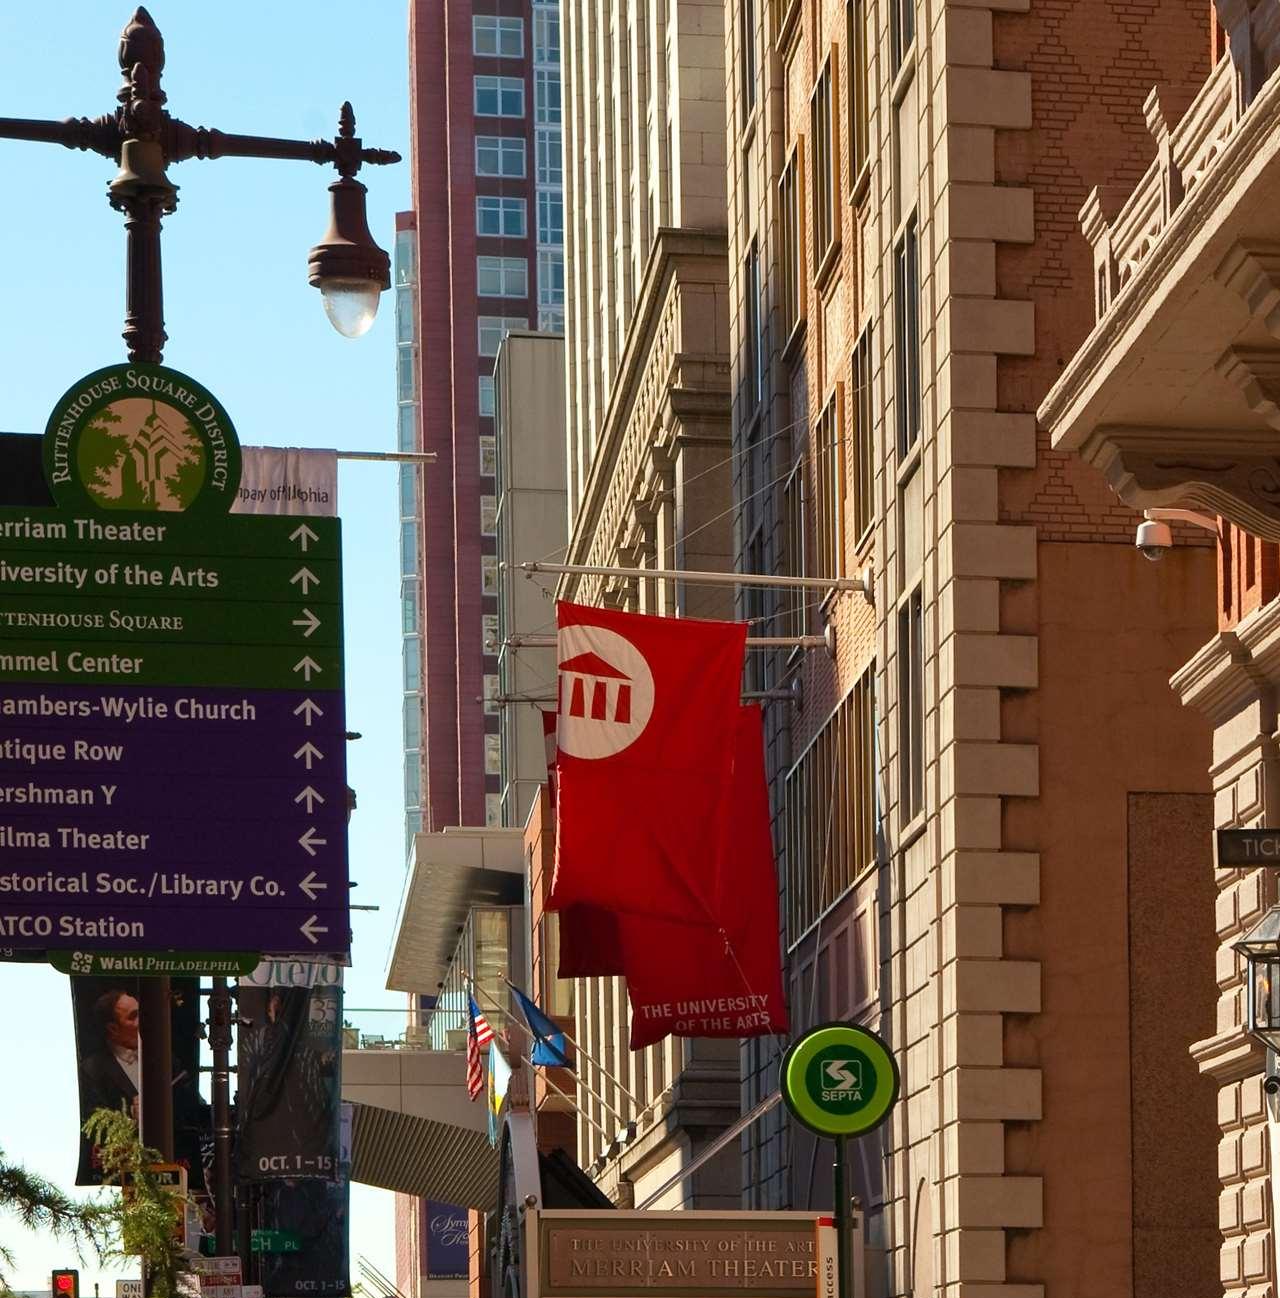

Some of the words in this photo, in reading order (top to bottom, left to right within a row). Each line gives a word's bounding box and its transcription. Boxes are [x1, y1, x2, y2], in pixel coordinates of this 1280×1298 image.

[126, 370, 197, 408] SQUARE
[195, 402, 228, 491] DISTRICT
[73, 519, 166, 542] Theater
[95, 563, 120, 585] of
[124, 565, 163, 586] the
[169, 566, 219, 588] Arts
[0, 612, 104, 628] TENHOUSE
[109, 610, 183, 631] SQUARE
[67, 652, 143, 674] Center
[0, 695, 168, 723] ambers-Wylie
[174, 698, 256, 721] Church
[0, 739, 66, 764] tique
[74, 740, 123, 761] Row
[100, 785, 118, 805] Y
[57, 828, 149, 850] Theater
[95, 872, 243, 900] Soc./Library
[250, 876, 286, 896] Co.
[59, 916, 145, 938] Station
[100, 956, 144, 971] Walk!
[146, 957, 240, 972] PHILADELPHIA
[641, 1003, 673, 1019] THE
[677, 994, 769, 1015] UNIVERSITY
[676, 1019, 697, 1031] OF
[700, 1017, 732, 1031] THE
[736, 1011, 771, 1030] ARTS
[822, 1090, 863, 1101] SEPTA
[259, 1155, 289, 1172] OCT.
[571, 1239, 603, 1251] THE
[613, 1239, 711, 1252] UNIVERSITY
[718, 1240, 739, 1252] OF
[745, 1240, 777, 1252] THE
[785, 1241, 816, 1253] ART
[571, 1259, 697, 1277] MERRIAM
[707, 1260, 818, 1277] THEATER
[122, 1283, 143, 1293] ONE
[295, 1280, 318, 1291] OCT.
